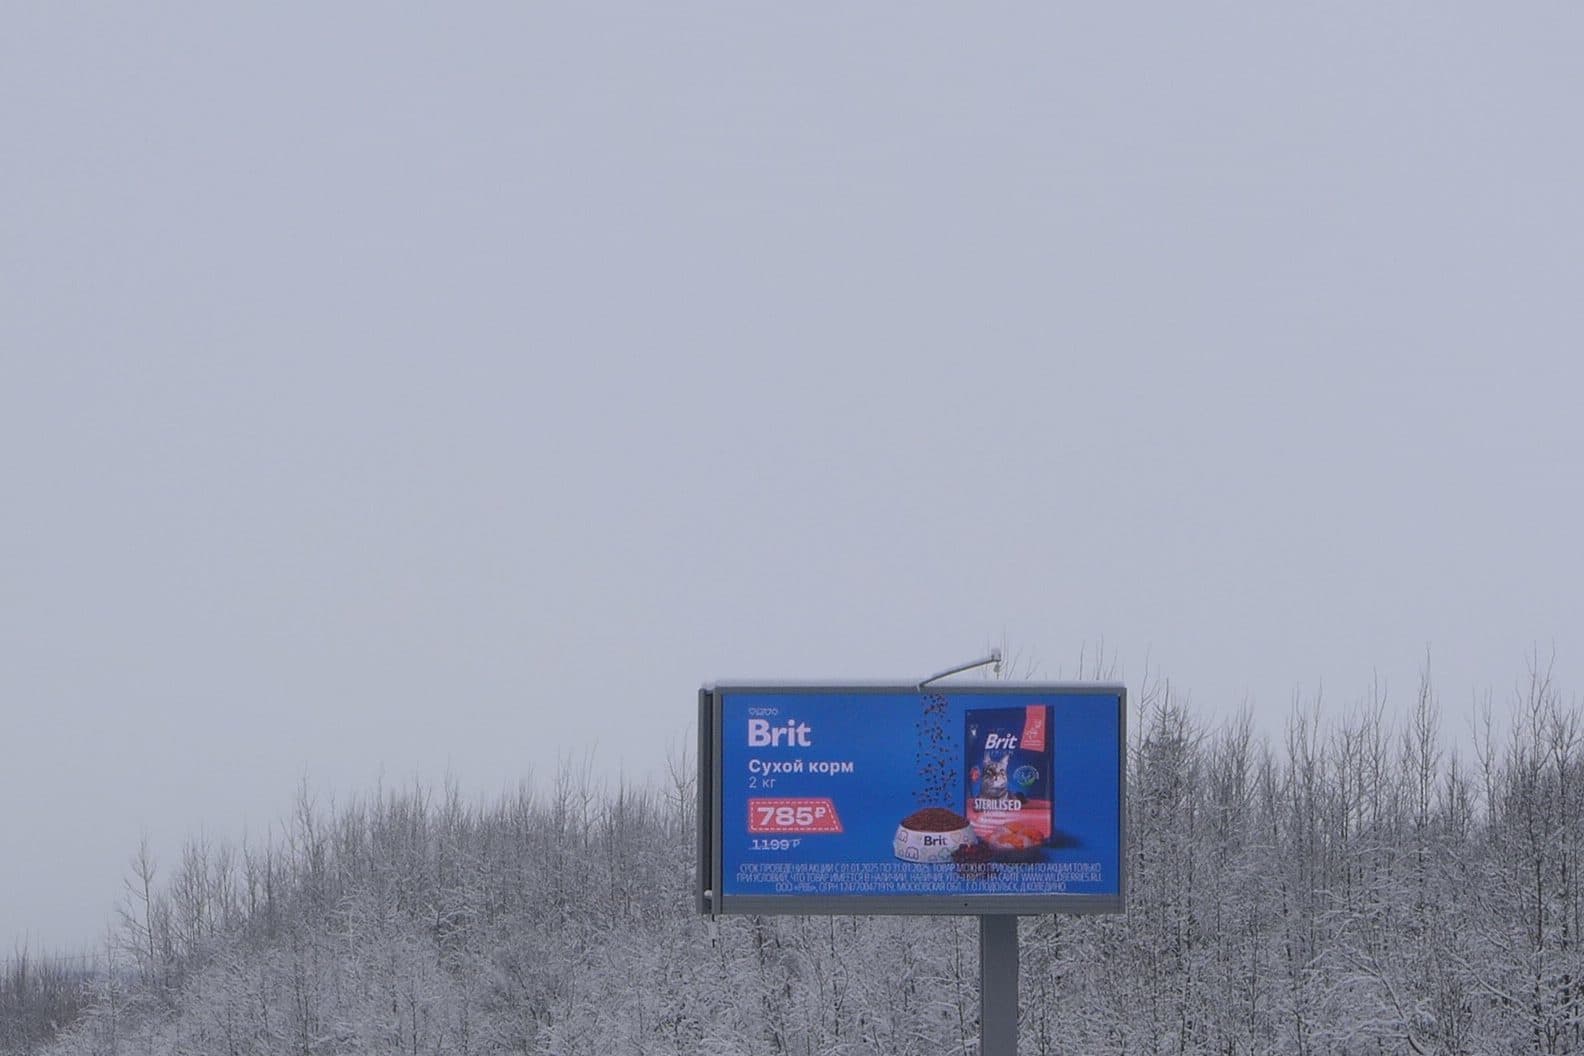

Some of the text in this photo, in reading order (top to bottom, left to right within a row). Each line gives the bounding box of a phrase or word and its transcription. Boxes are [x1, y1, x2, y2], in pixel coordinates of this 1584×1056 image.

[748, 719, 812, 747] Brit
[984, 733, 1018, 750] Brit
[748, 759, 854, 776] Сухой корм
[748, 777, 776, 789] 2 кг
[974, 798, 1022, 811] STERILISED
[923, 835, 948, 846] Brit
